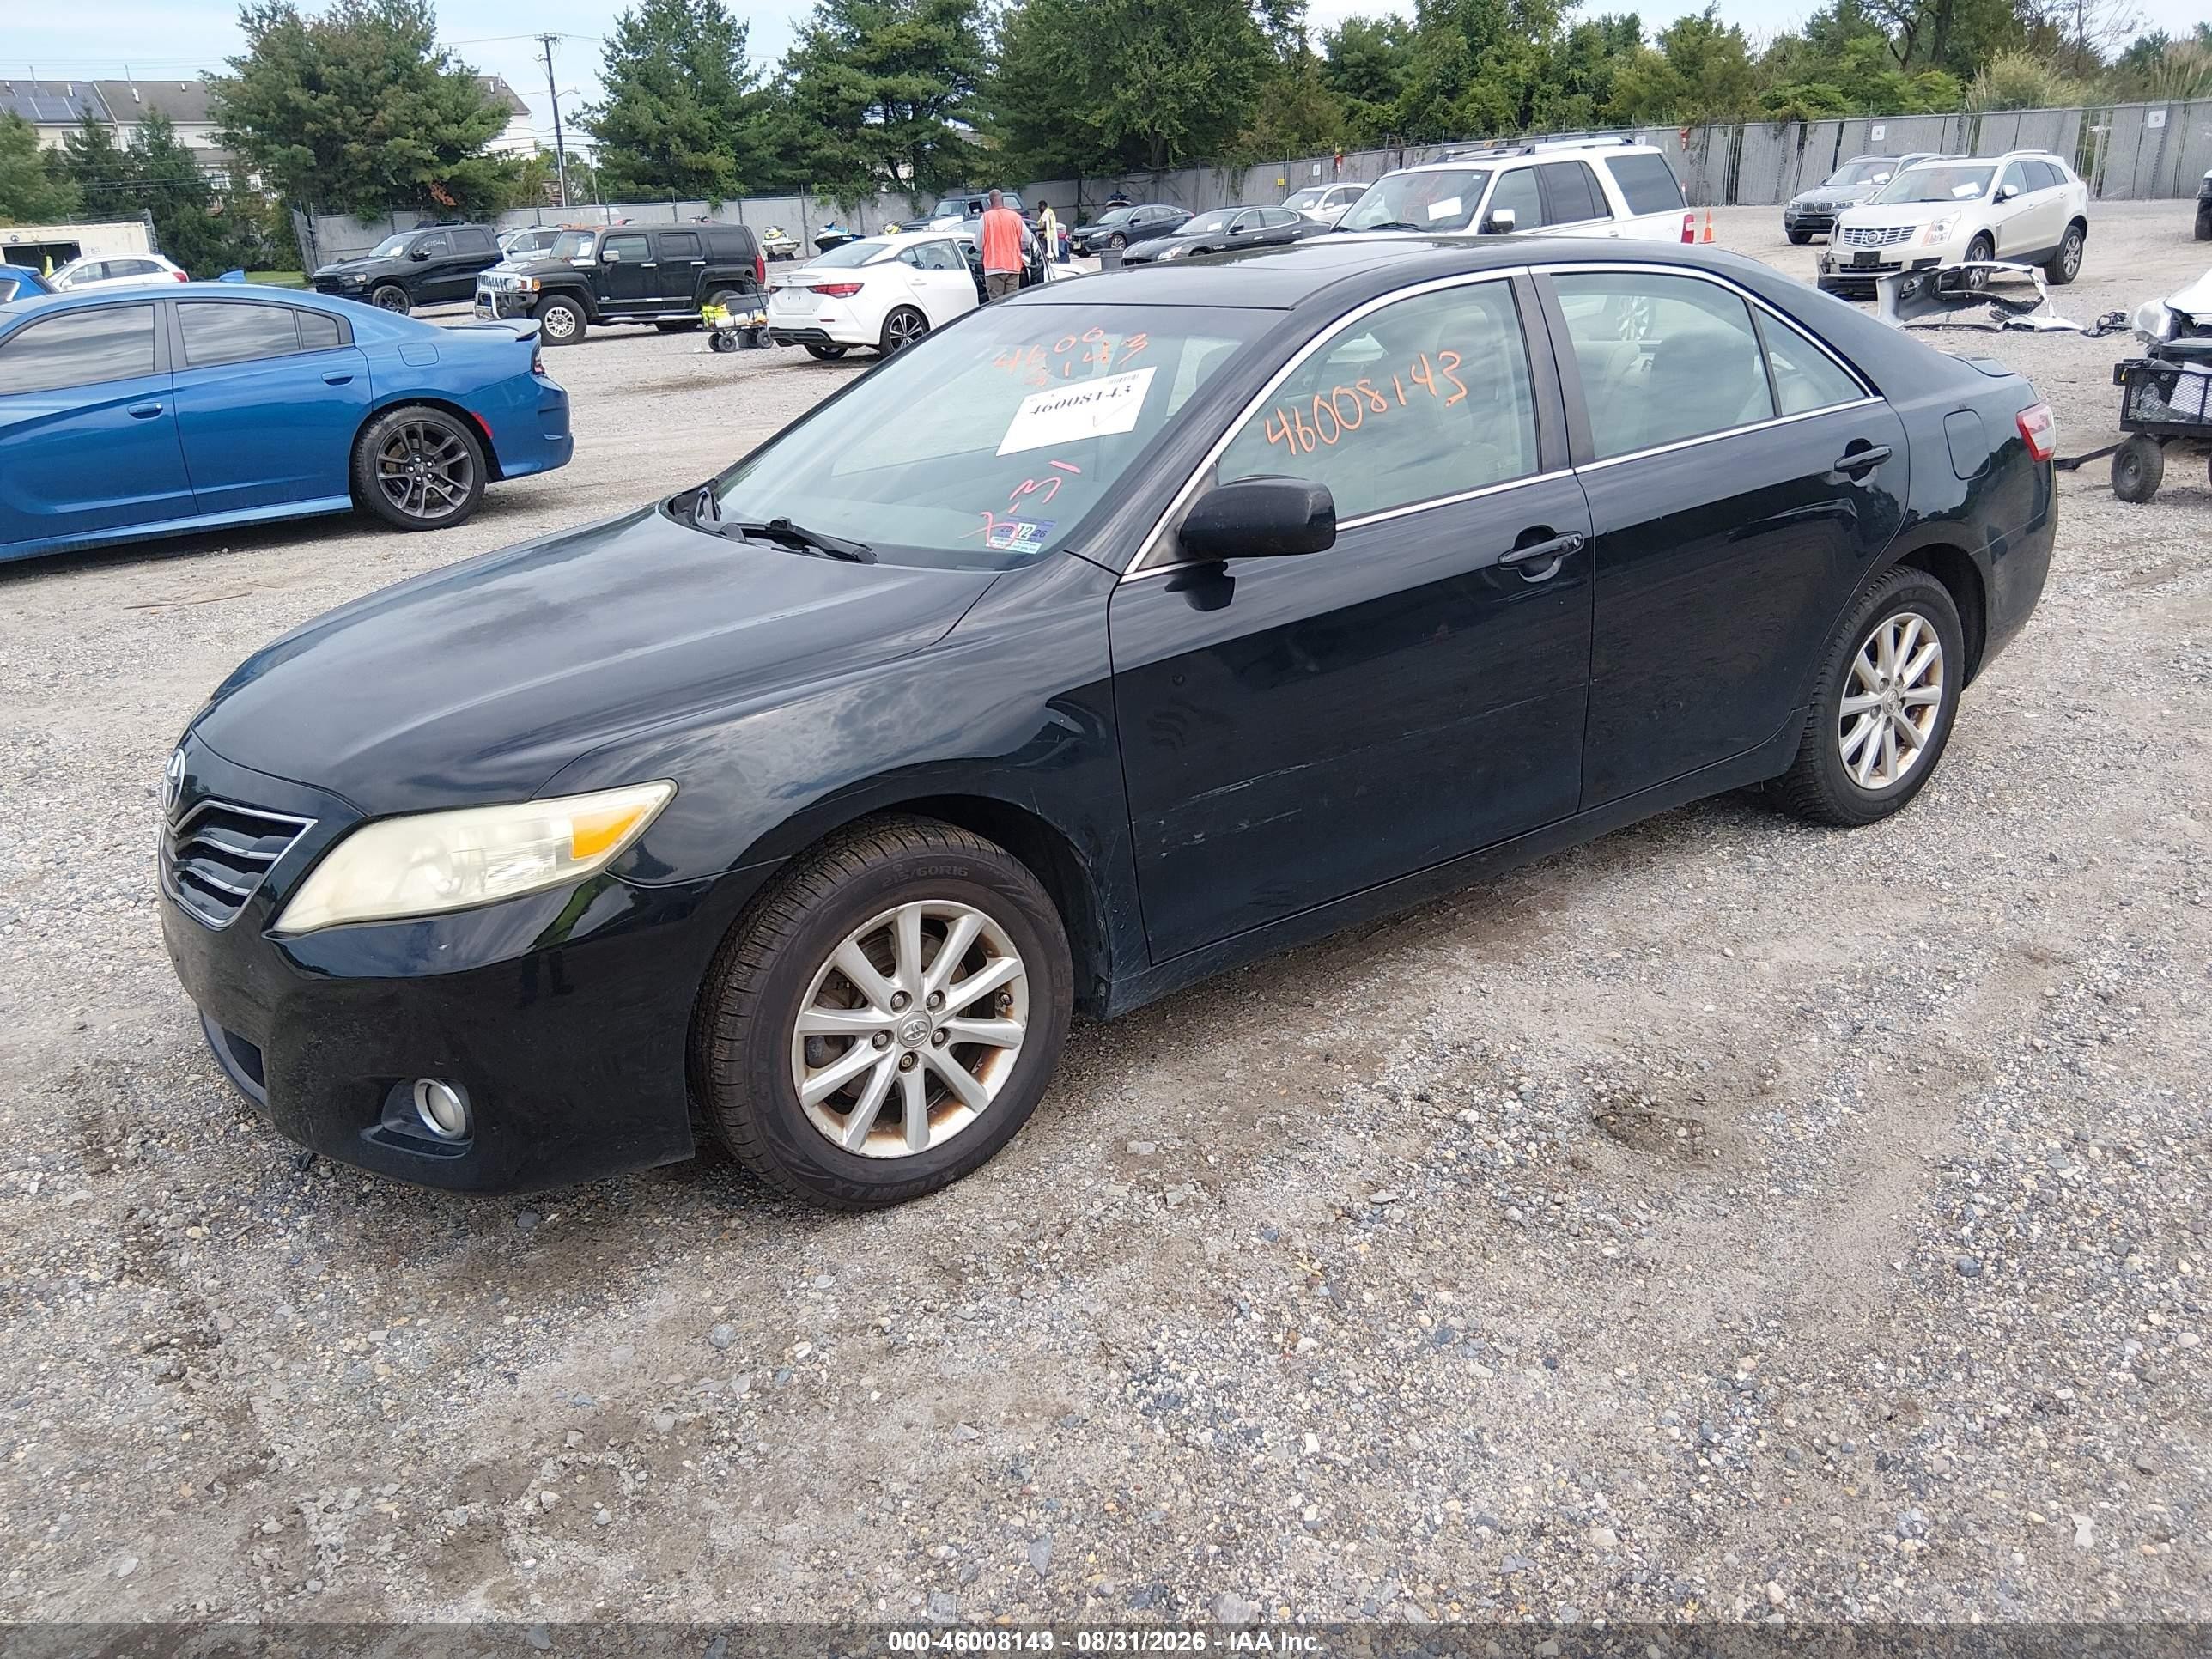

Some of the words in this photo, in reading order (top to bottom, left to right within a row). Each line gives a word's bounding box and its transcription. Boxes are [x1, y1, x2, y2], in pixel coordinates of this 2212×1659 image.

[1029, 384, 1131, 415] 46008143
[1264, 349, 1468, 455] 46008143
[1017, 524, 1035, 539] 12
[1032, 528, 1049, 538] 26
[881, 865, 969, 889] 215/60R16
